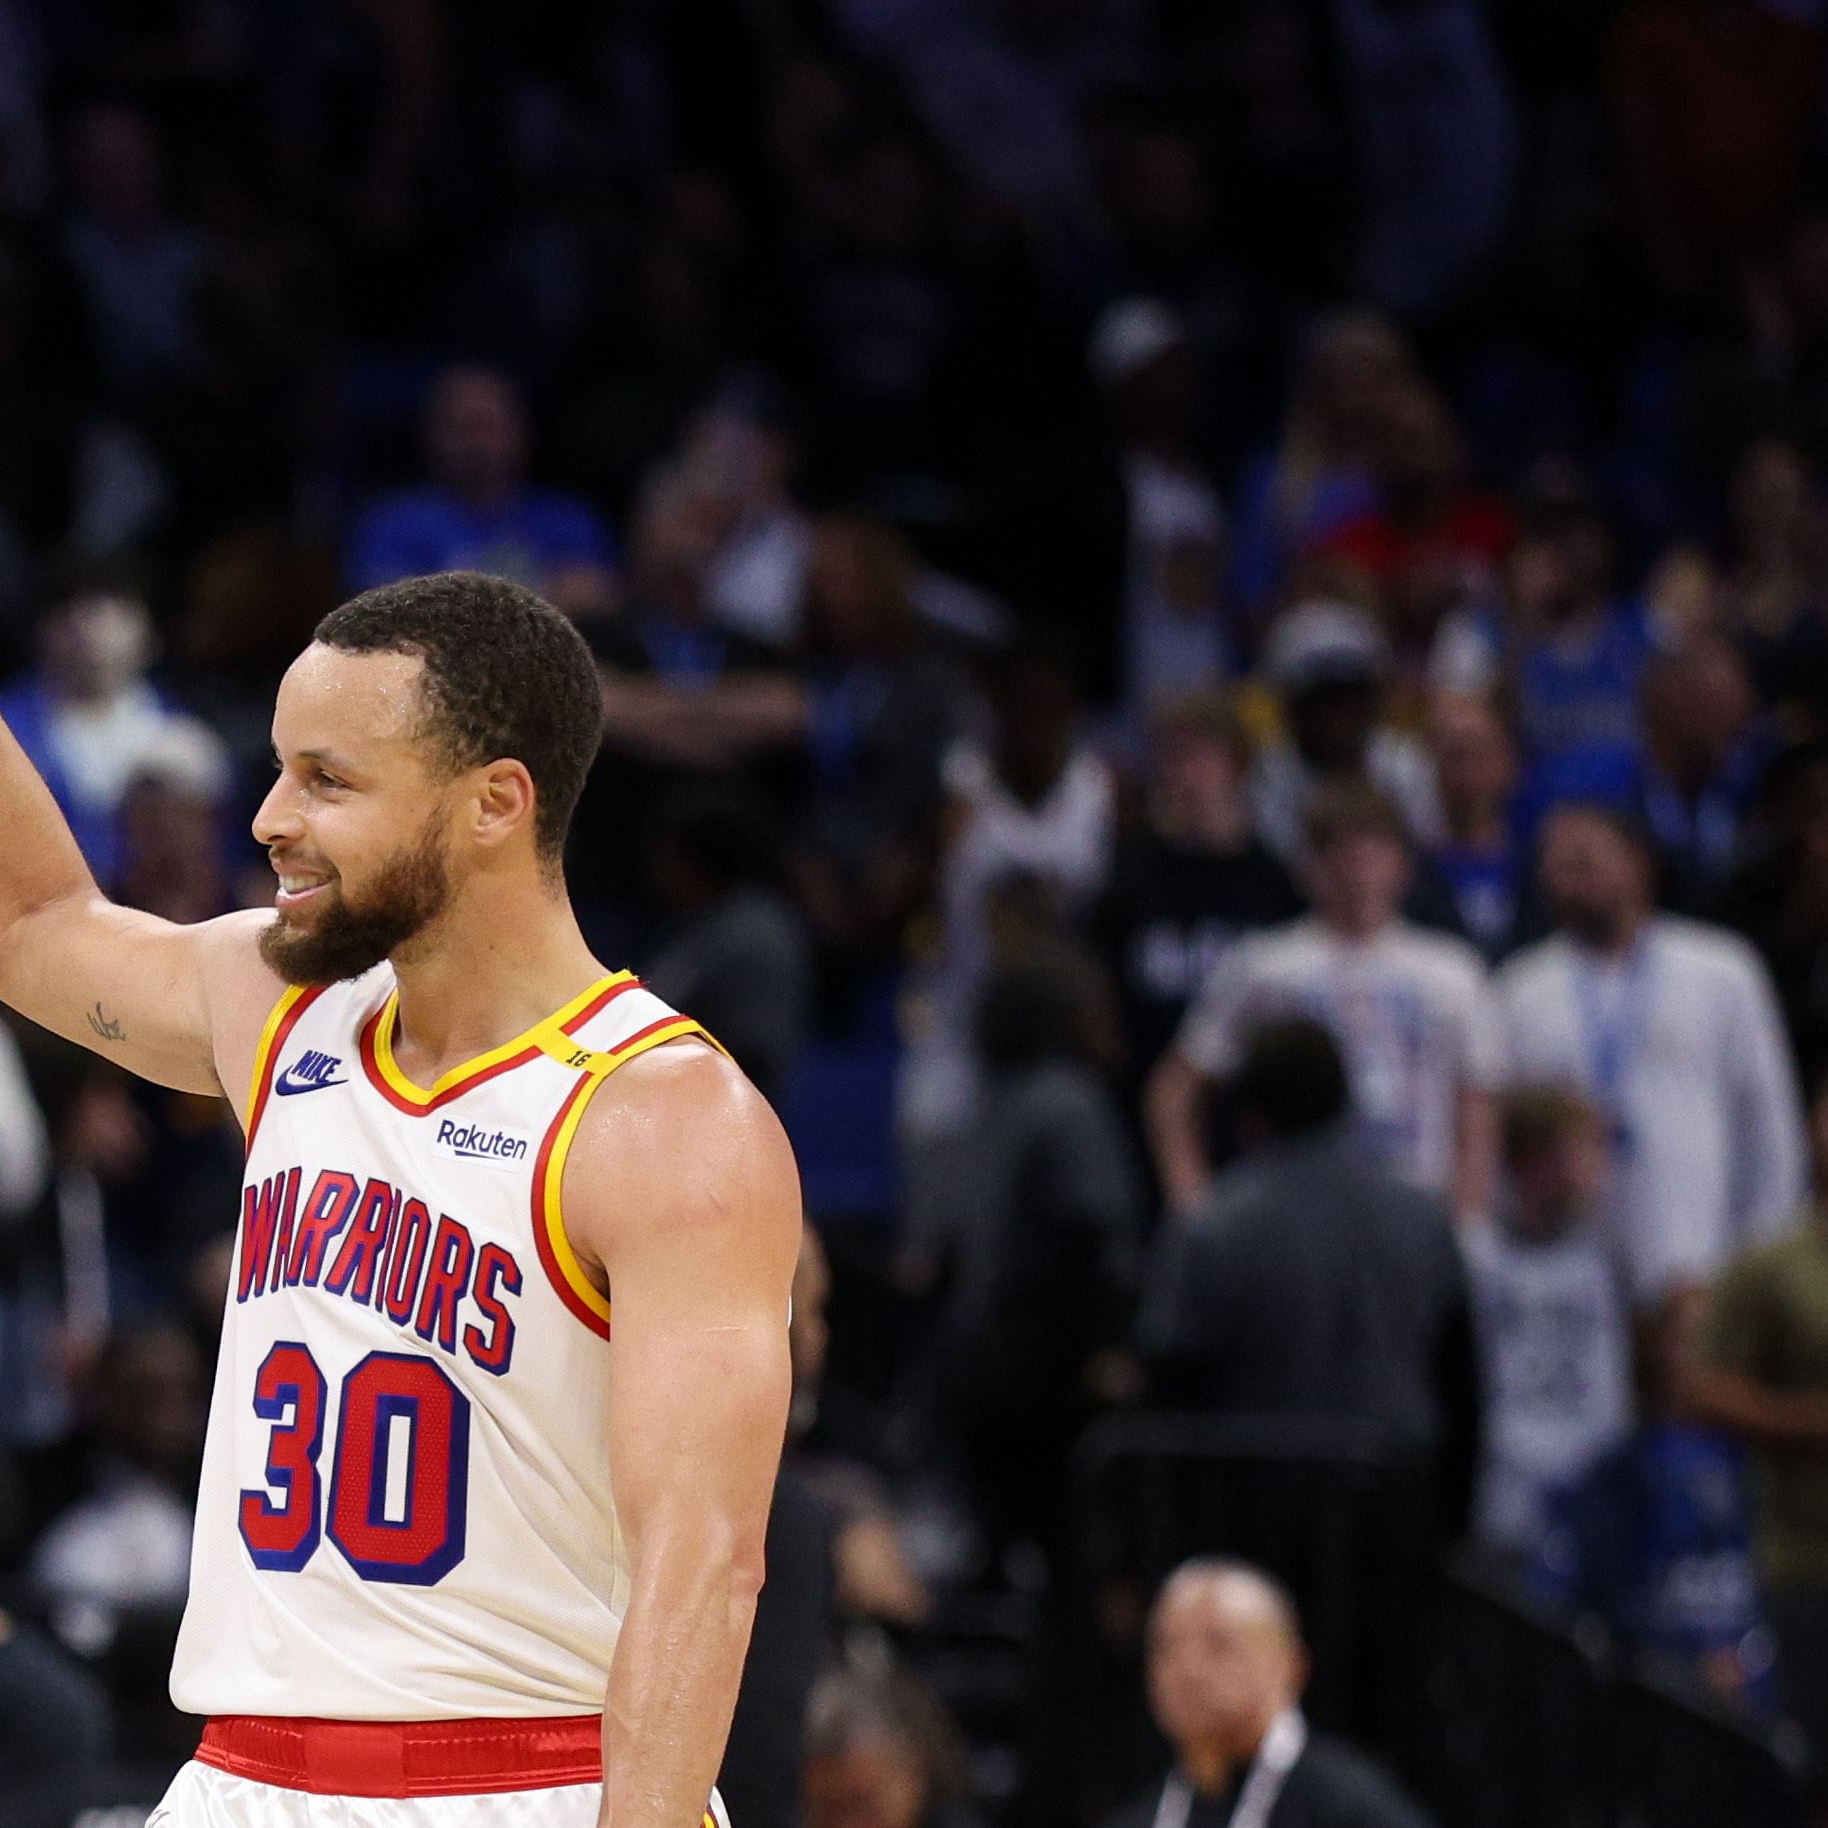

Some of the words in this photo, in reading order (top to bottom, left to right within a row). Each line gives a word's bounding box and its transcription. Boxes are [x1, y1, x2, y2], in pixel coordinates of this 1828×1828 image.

[290, 1048, 339, 1082] NIKE
[436, 1118, 528, 1161] Rakuten
[237, 1167, 524, 1377] WARRIORS
[237, 1340, 471, 1587] 30
